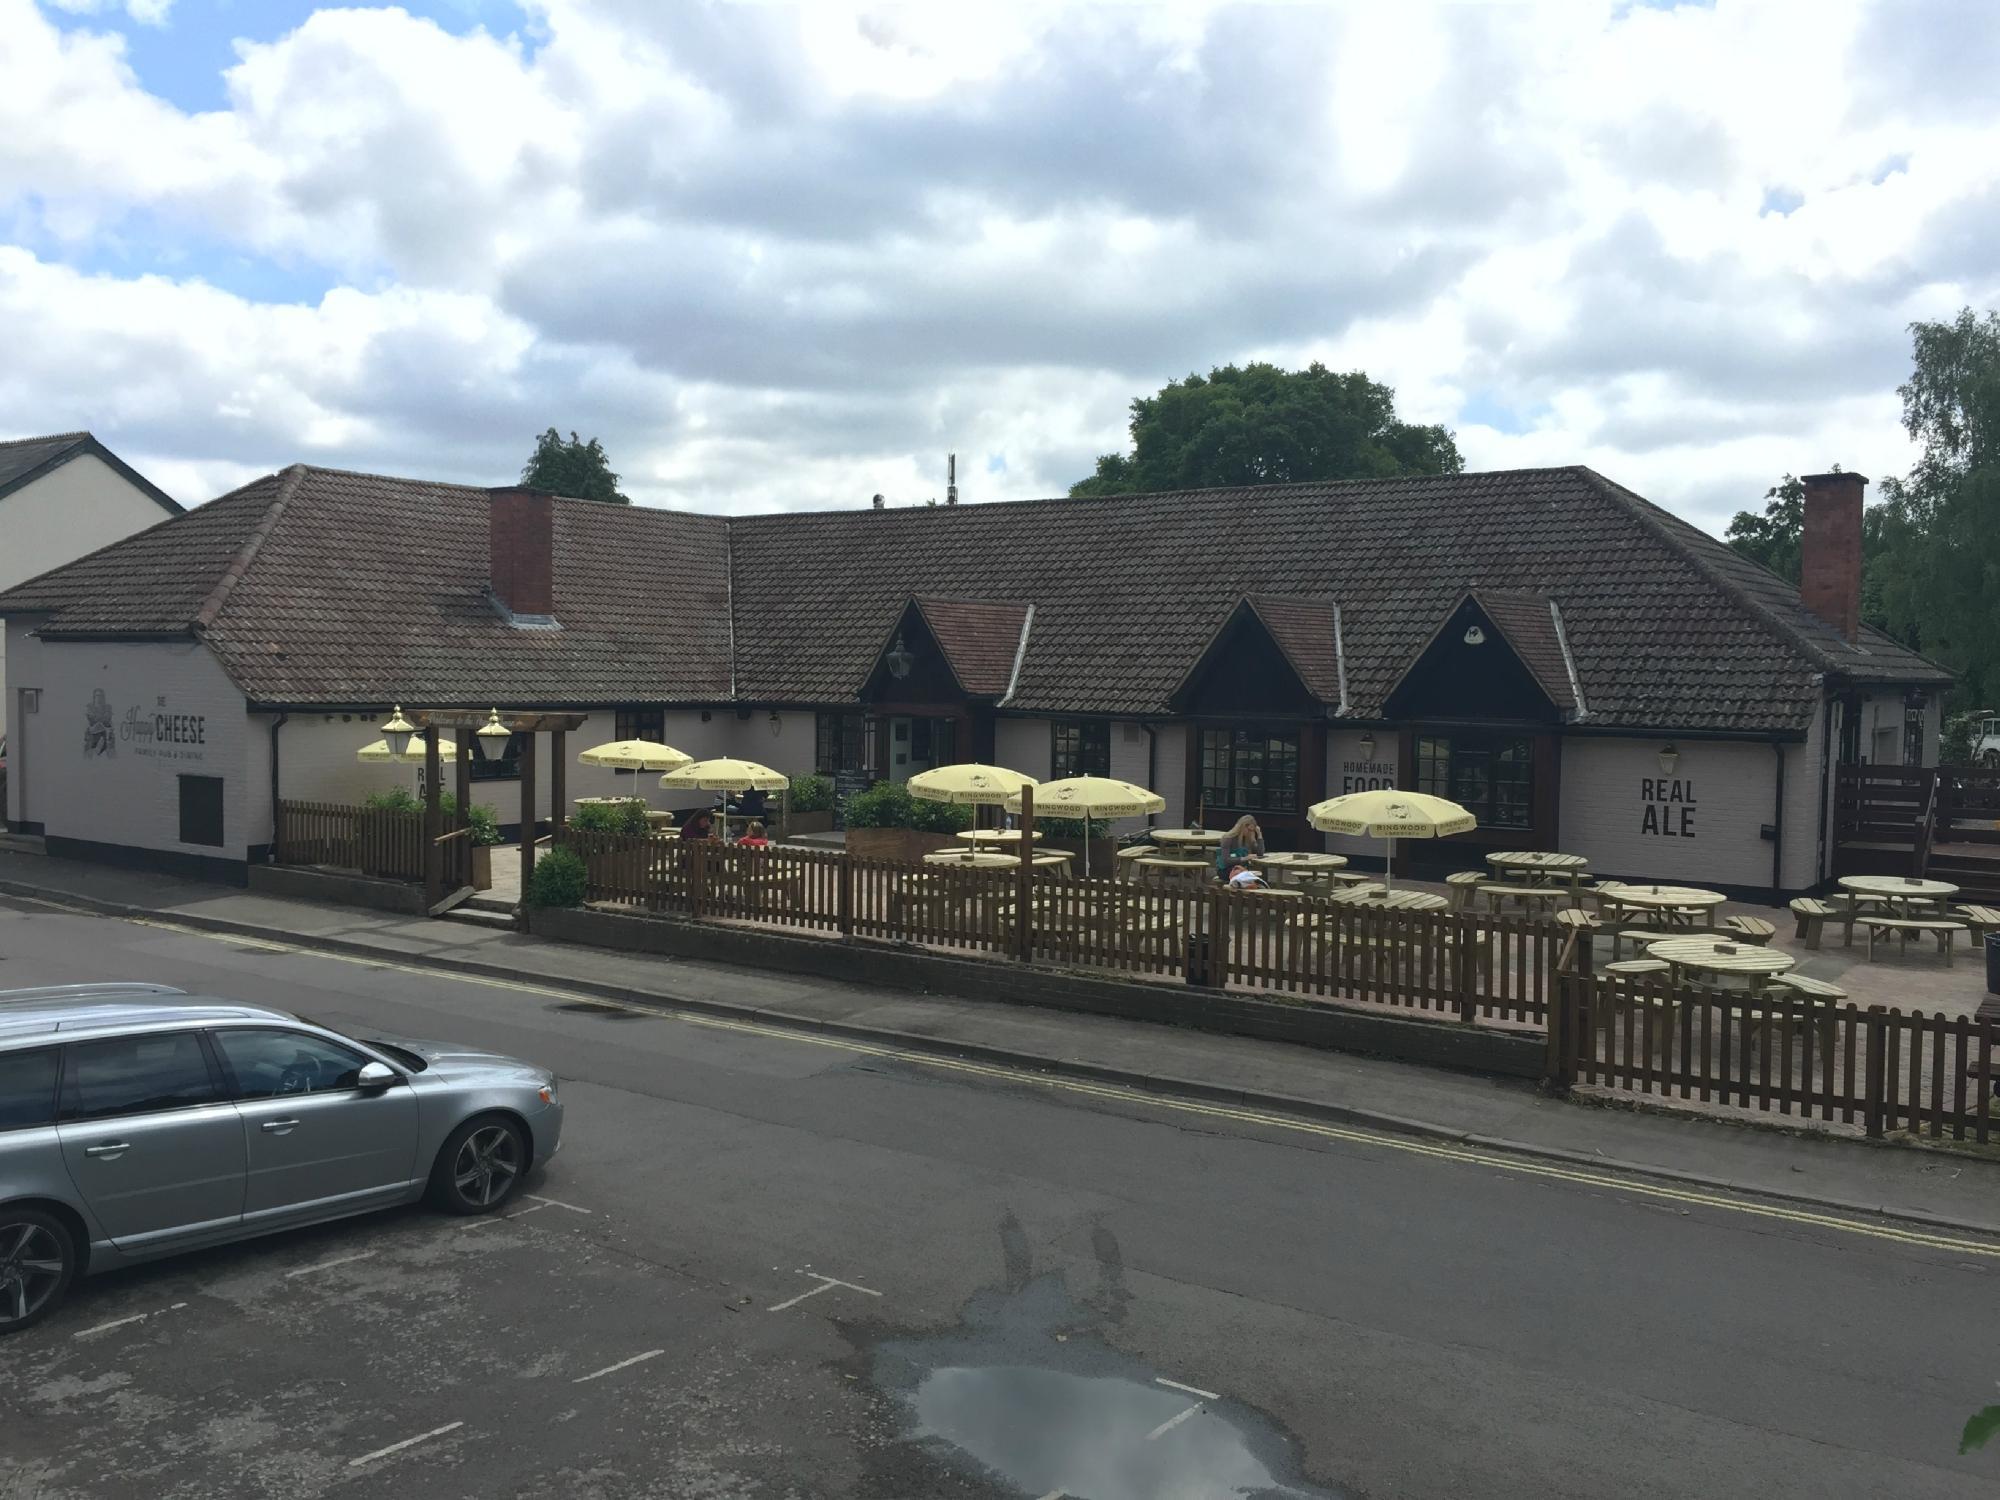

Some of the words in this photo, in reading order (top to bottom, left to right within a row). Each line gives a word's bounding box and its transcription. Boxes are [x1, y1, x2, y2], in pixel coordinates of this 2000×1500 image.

[157, 714, 205, 744] CHEESE
[1343, 761, 1394, 775] HOMEMADE
[960, 791, 1002, 799] RINGWOOD
[1642, 778, 1697, 803] REAL
[1036, 804, 1081, 812] RINGWOOD
[1322, 818, 1362, 829] RINGWOOD
[1641, 804, 1696, 838] ALE
